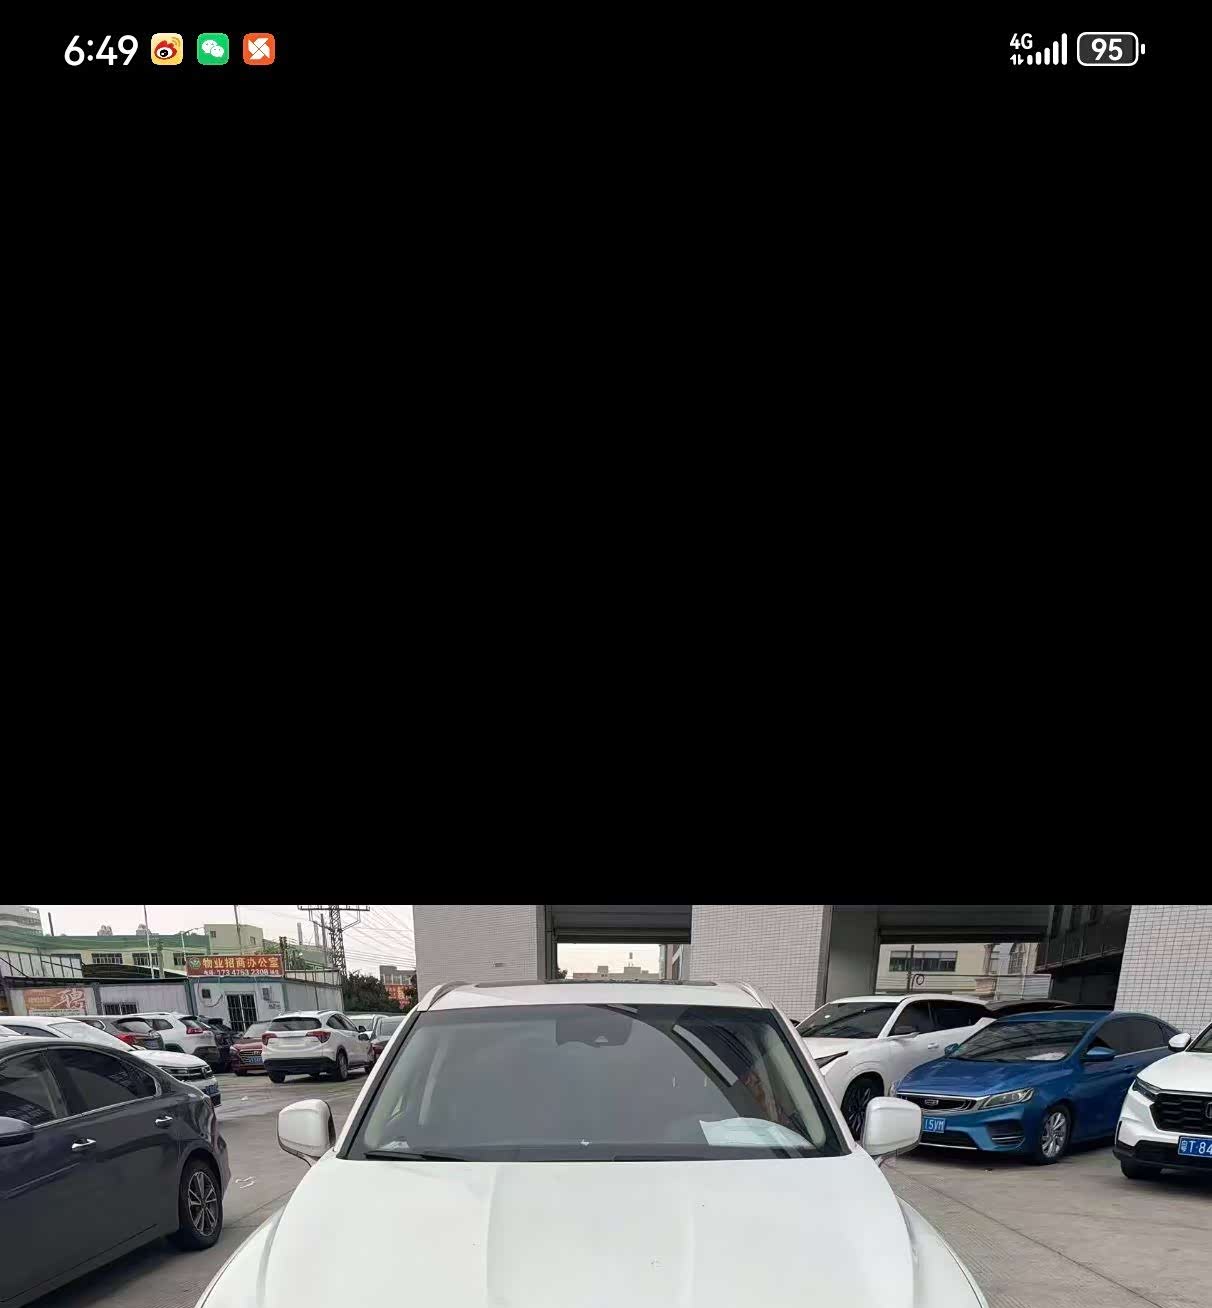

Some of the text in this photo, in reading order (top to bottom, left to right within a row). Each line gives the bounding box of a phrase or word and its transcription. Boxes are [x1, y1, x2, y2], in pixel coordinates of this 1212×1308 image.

[203, 957, 279, 969] 物业招商办公室
